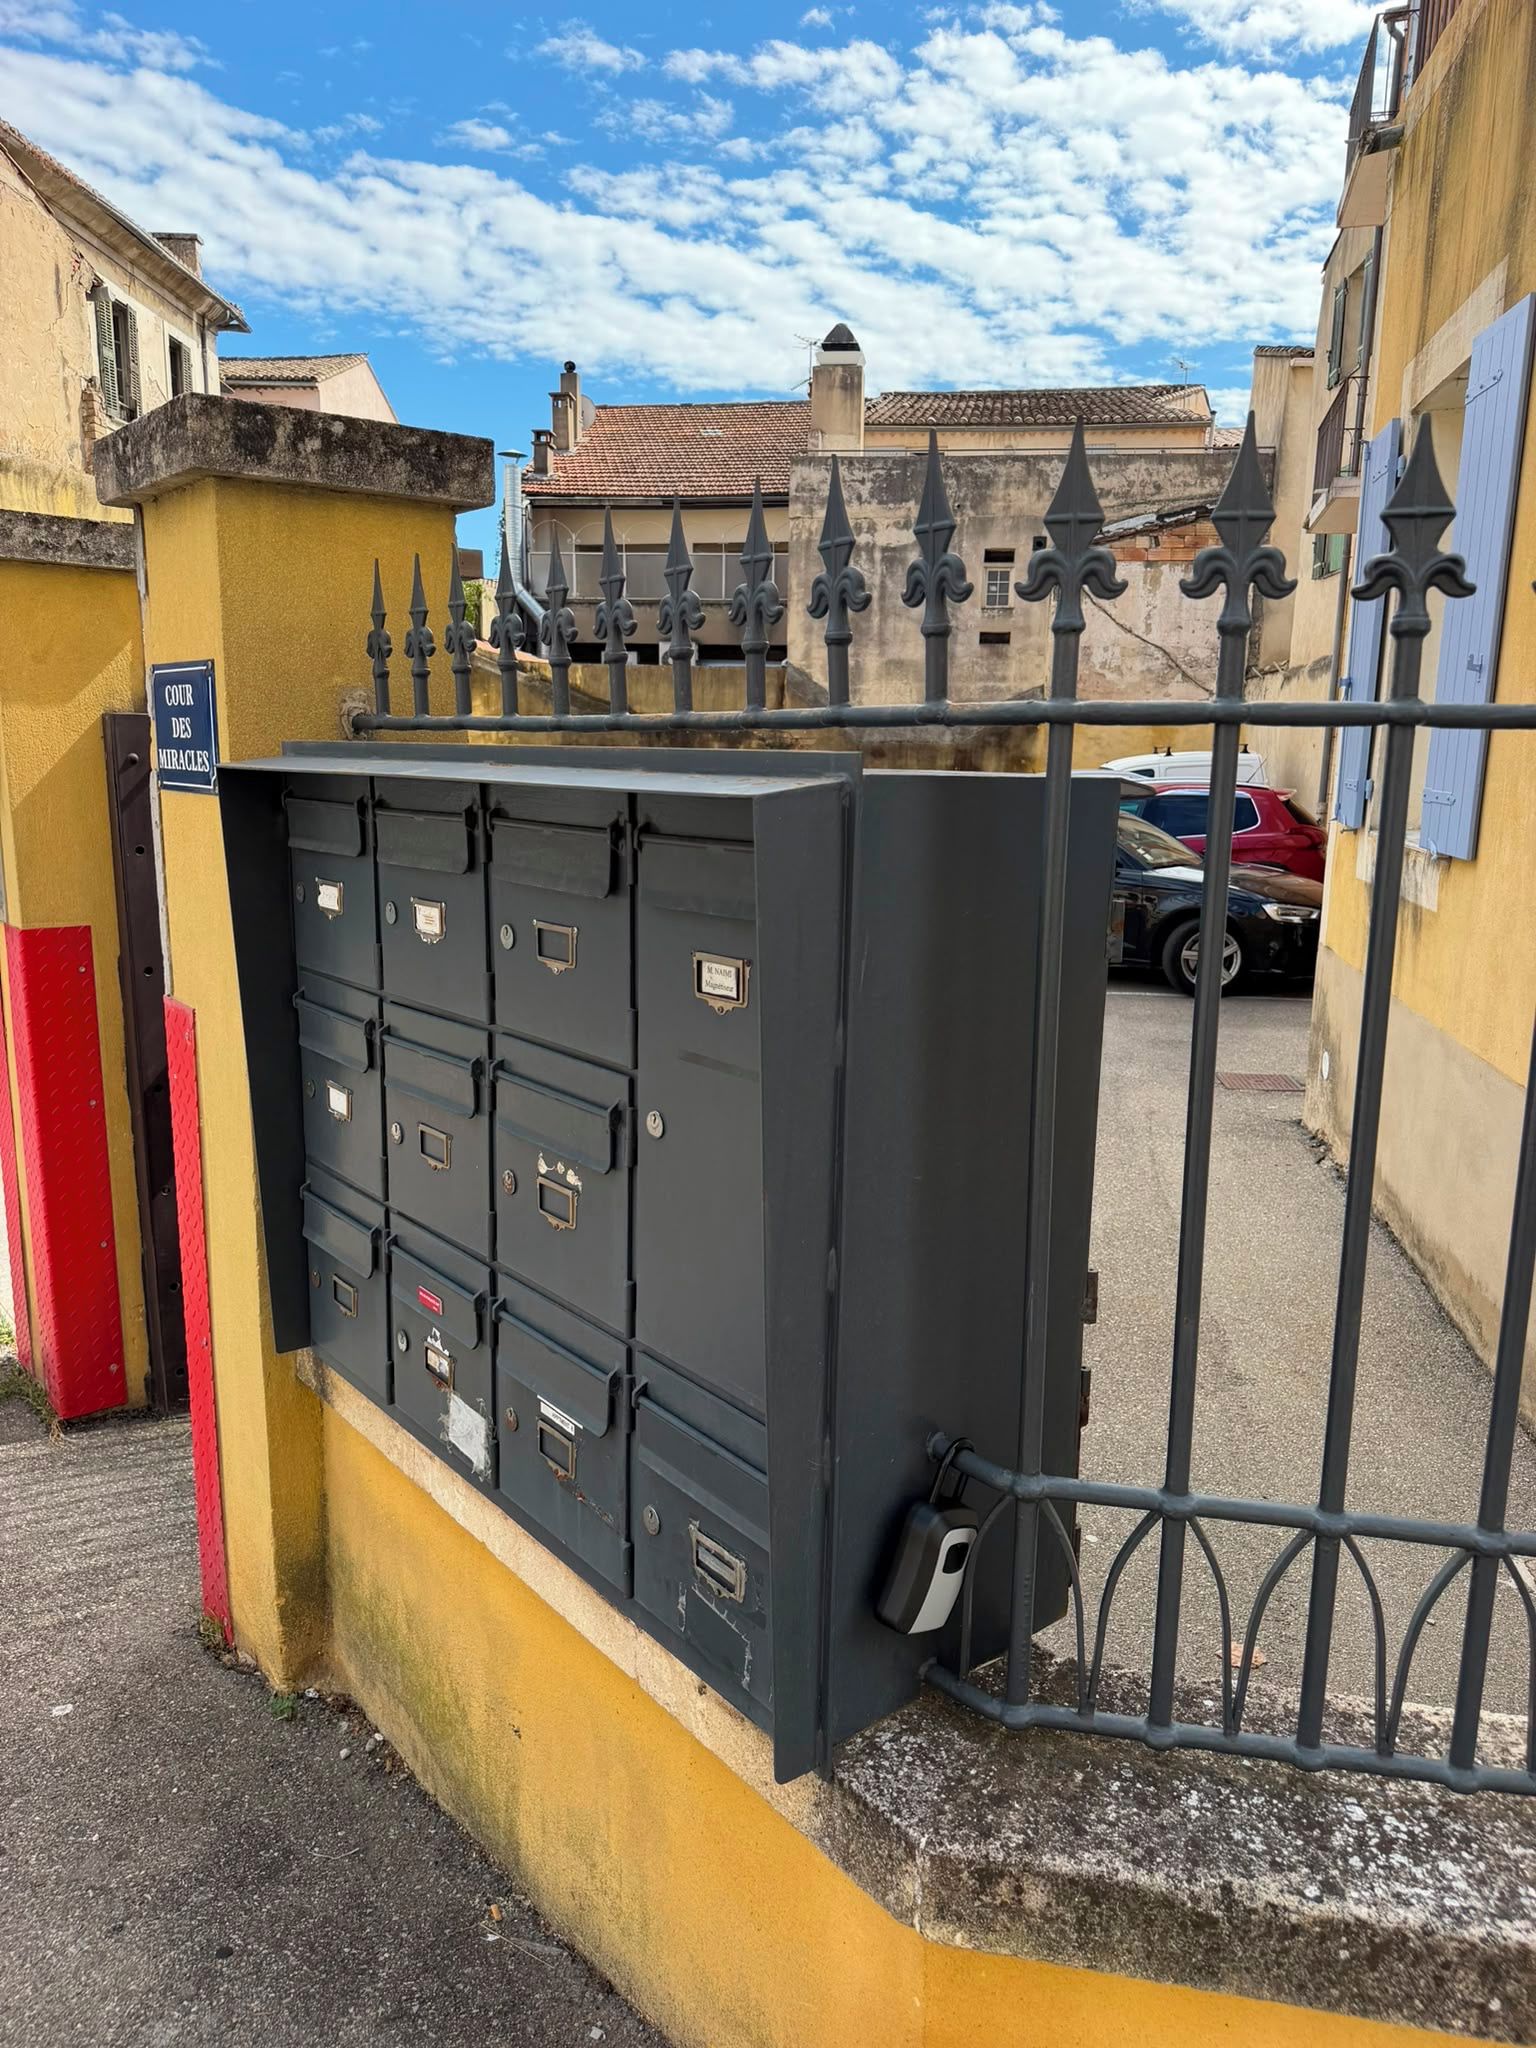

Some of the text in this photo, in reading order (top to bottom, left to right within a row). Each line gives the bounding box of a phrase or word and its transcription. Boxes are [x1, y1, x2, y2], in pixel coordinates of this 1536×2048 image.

[165, 684, 194, 706] COUR
[171, 717, 192, 739] DES
[159, 748, 210, 773] MIRACLES
